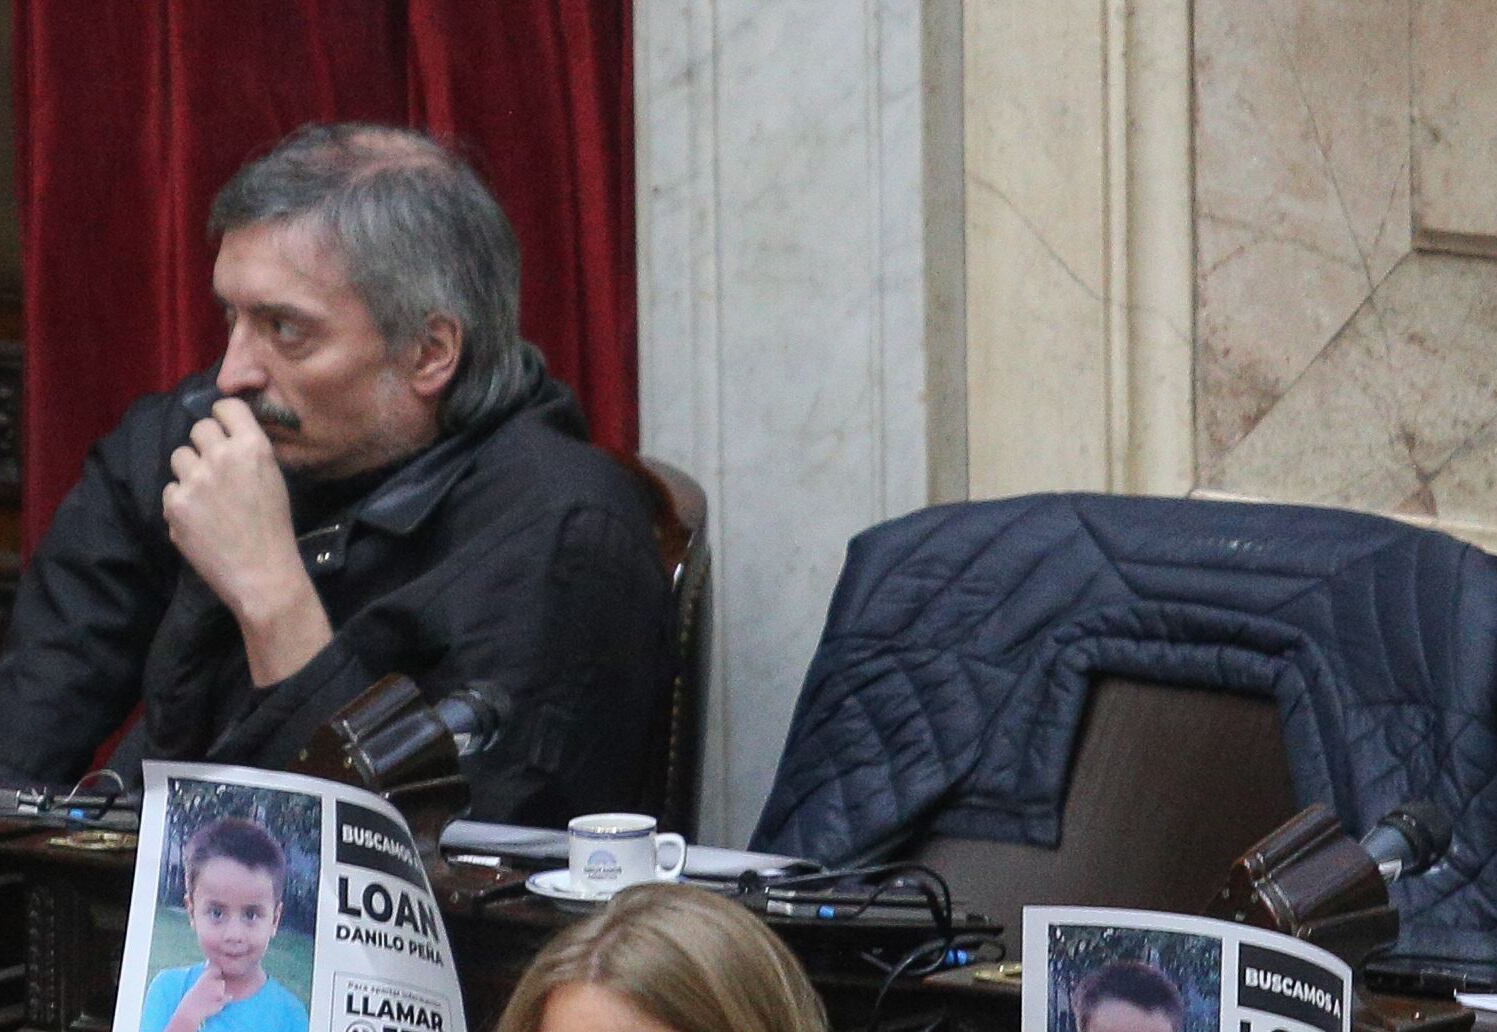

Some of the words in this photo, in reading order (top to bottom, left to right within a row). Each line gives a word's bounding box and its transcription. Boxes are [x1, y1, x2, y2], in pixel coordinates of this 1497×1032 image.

[342, 823, 414, 867] BUSCAMOS
[337, 876, 440, 944] LOAN
[336, 924, 404, 952] DANILO
[408, 938, 444, 967] PEÑA
[346, 993, 443, 1032] LLAMAR
[1245, 967, 1333, 1013] BUSCAMOS
[1333, 998, 1341, 1019] A
